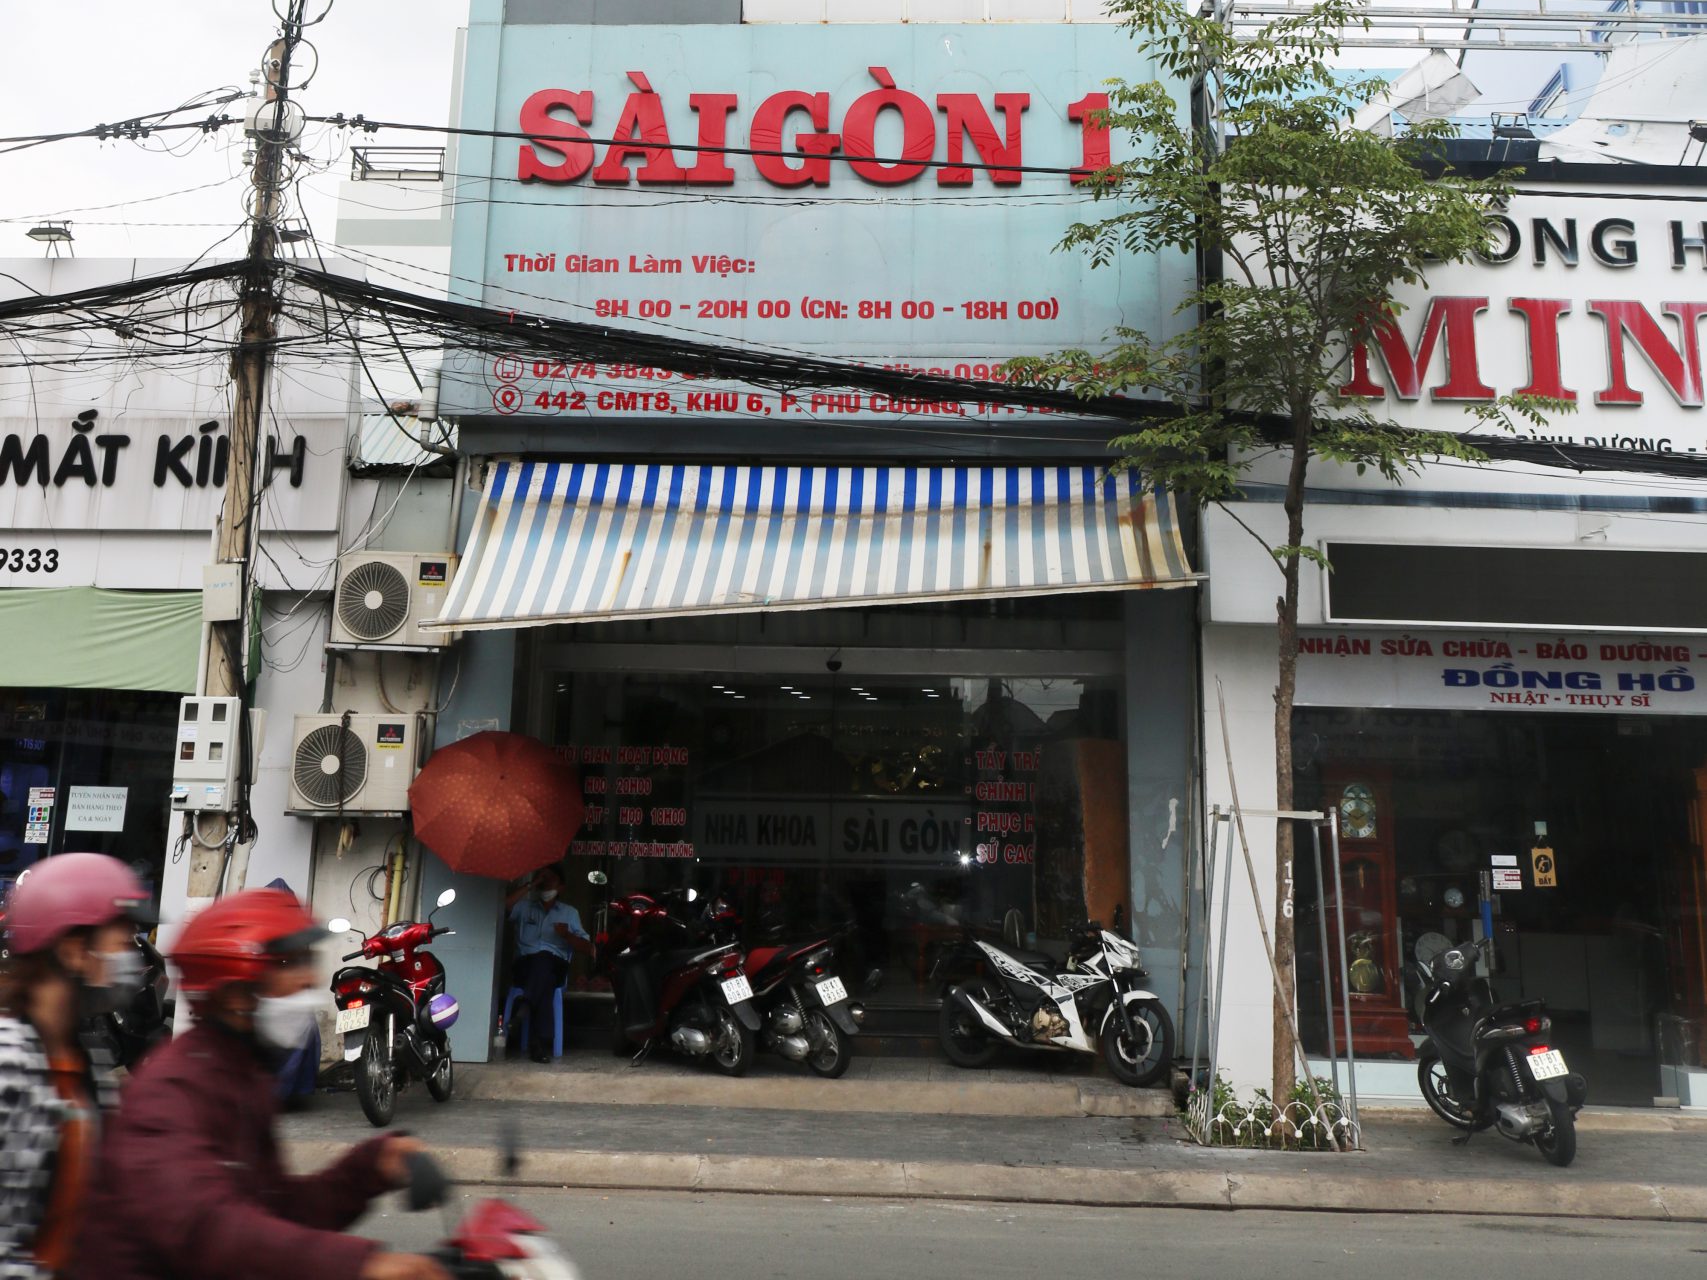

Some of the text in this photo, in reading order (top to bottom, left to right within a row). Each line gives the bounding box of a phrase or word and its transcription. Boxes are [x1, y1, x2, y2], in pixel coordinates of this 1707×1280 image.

[1066, 92, 1118, 186] 1
[1420, 195, 1639, 270] ỒNG
[504, 253, 756, 278] Thời Gian Làm Việc:
[595, 298, 629, 318] 8H
[639, 298, 672, 318] 00
[698, 299, 747, 319] 20H
[757, 300, 790, 319] 00
[801, 297, 849, 321] (CN:
[858, 300, 891, 319] 8H
[901, 301, 934, 320] 00
[961, 301, 1007, 320] 18H
[1018, 297, 1059, 321] 00)
[535, 390, 587, 410] 442
[596, 391, 677, 414] CMT8,
[686, 392, 739, 412] KHU
[746, 393, 771, 416] 6,
[781, 394, 802, 413] P.
[811, 389, 860, 414] PHÚ
[0, 409, 131, 488] MẮT
[1299, 638, 1371, 660] NHẬN
[1381, 634, 1433, 657] SỬA
[1443, 638, 1512, 659] CHỮA
[1537, 638, 1588, 660] BẢO
[1600, 640, 1690, 662] DƯỠNG
[1441, 662, 1695, 692] ĐỒNG HỒ
[1490, 692, 1549, 706] NHẬT
[704, 808, 960, 854] NHA KHOA SÀI GÒN
